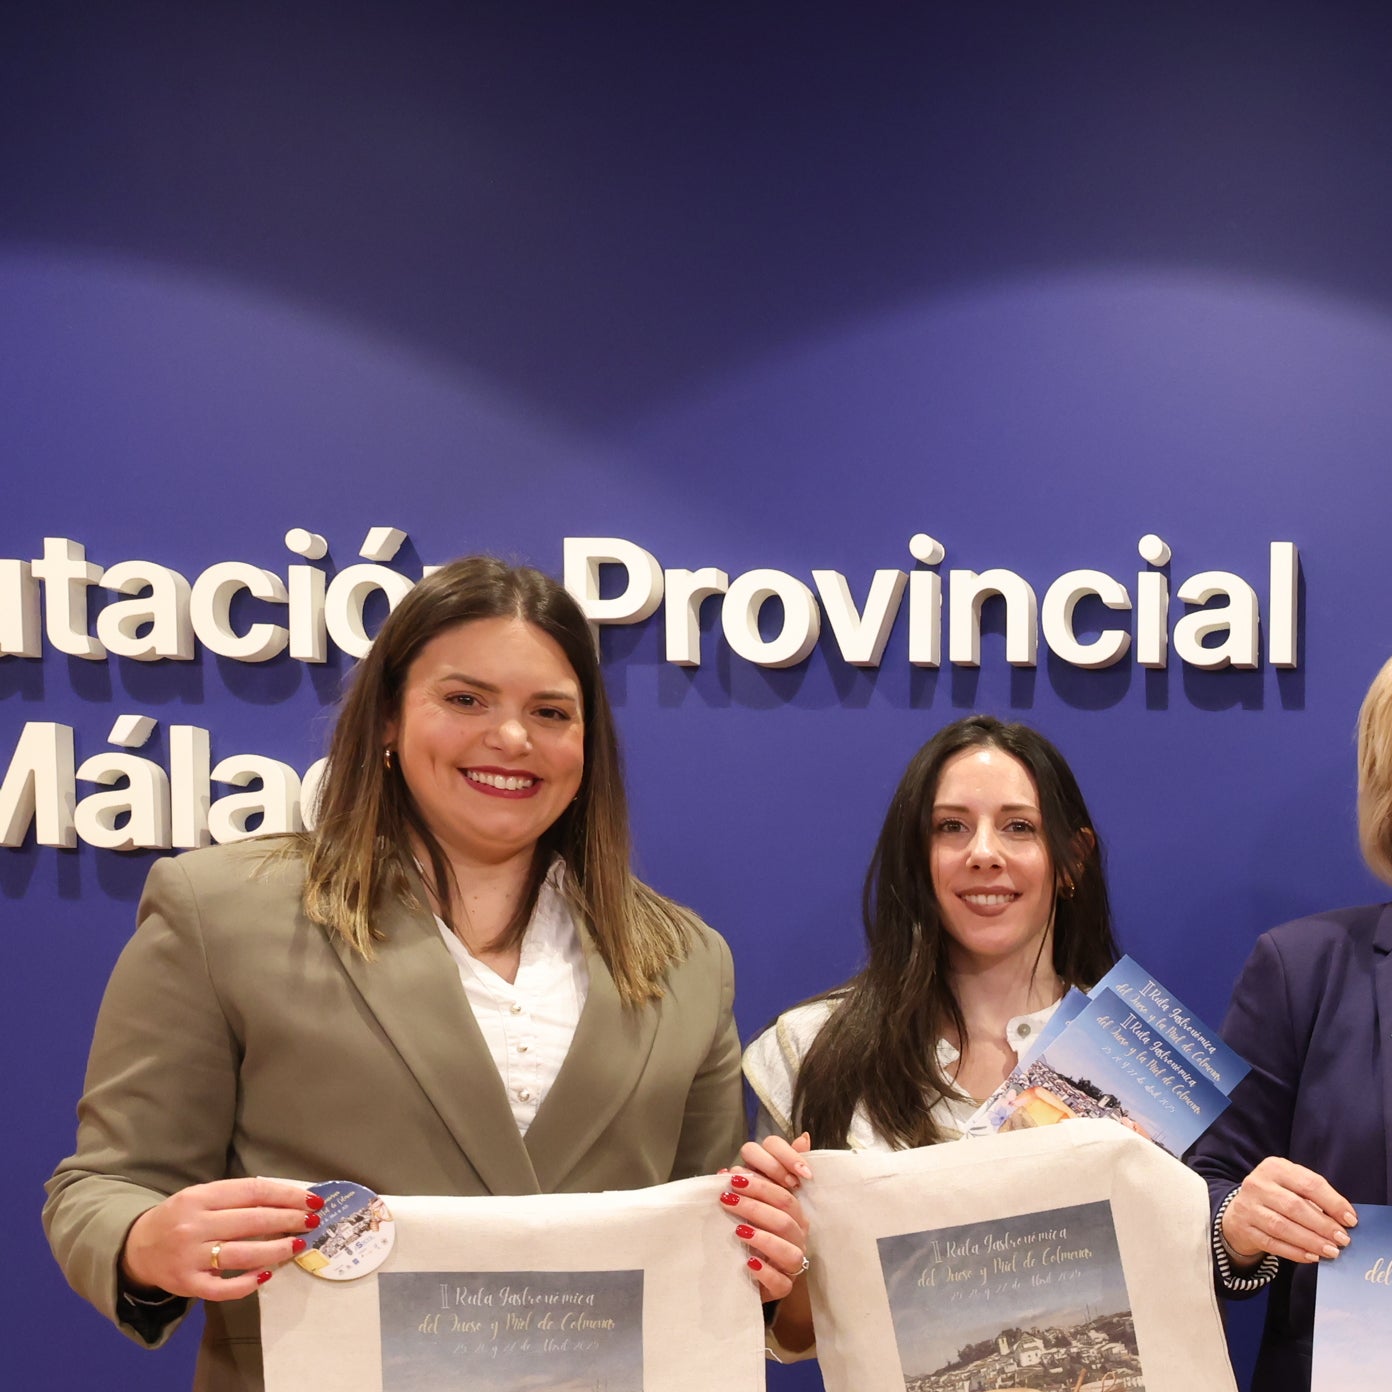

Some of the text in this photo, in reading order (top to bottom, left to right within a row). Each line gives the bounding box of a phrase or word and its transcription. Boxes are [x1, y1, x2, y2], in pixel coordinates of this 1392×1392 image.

[0, 527, 1298, 670] tació Provincial
[1364, 1258, 1392, 1286] del
